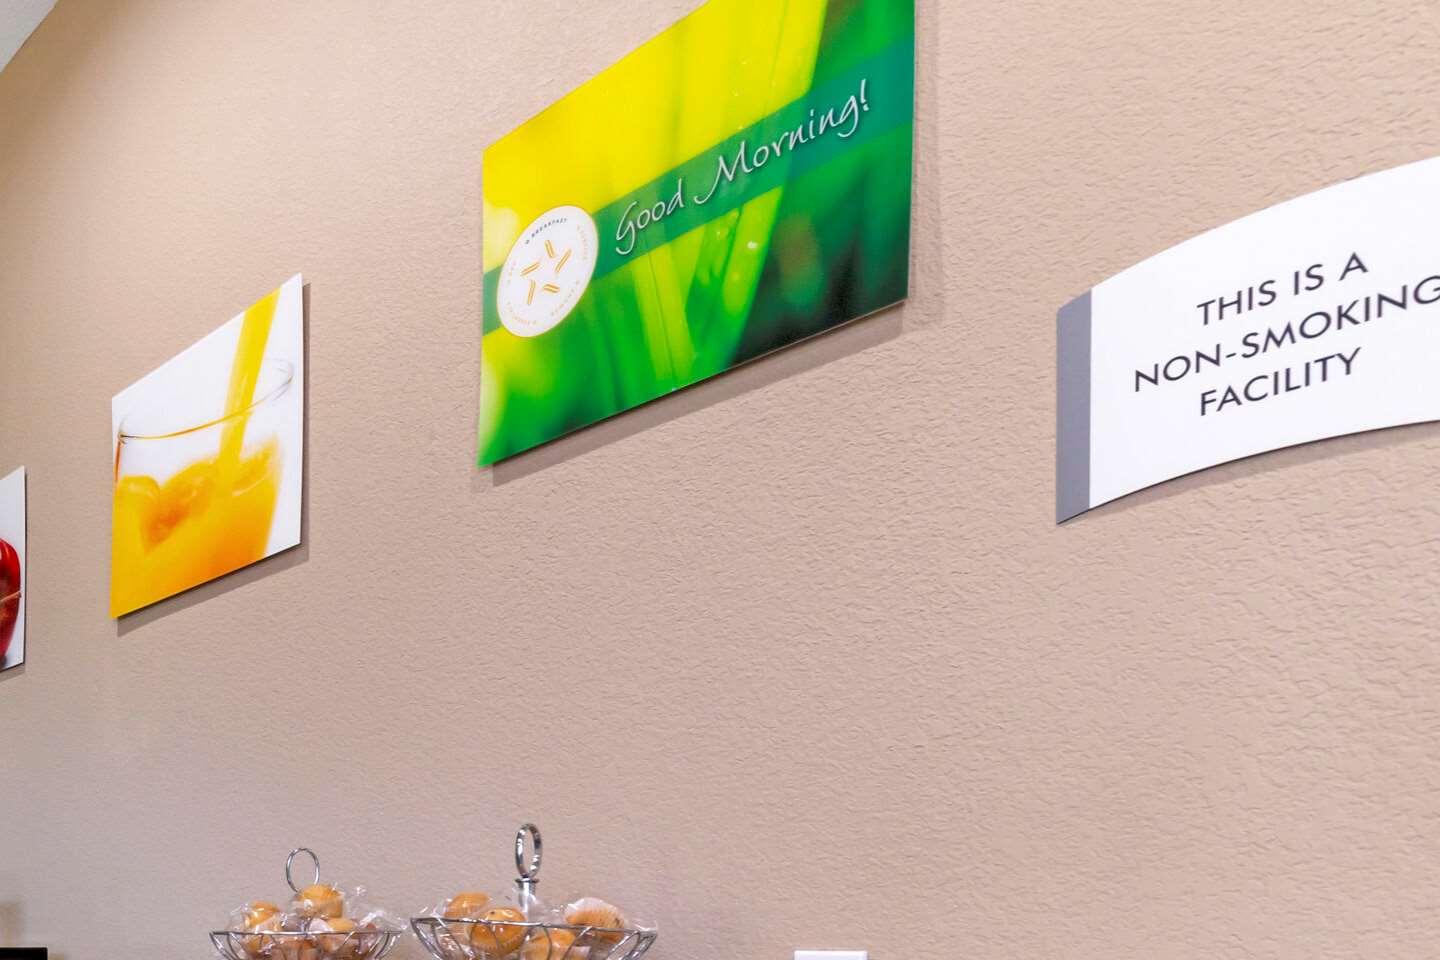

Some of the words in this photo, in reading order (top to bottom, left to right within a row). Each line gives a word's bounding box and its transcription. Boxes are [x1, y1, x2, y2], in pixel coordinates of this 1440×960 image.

[614, 178, 686, 258] Good
[693, 78, 871, 206] Morning!
[1133, 275, 1440, 393] NON-SMOKING
[1195, 279, 1278, 327] THIS
[1292, 263, 1325, 297] IS
[1338, 250, 1370, 282] A
[1199, 346, 1363, 418] FACILITY
